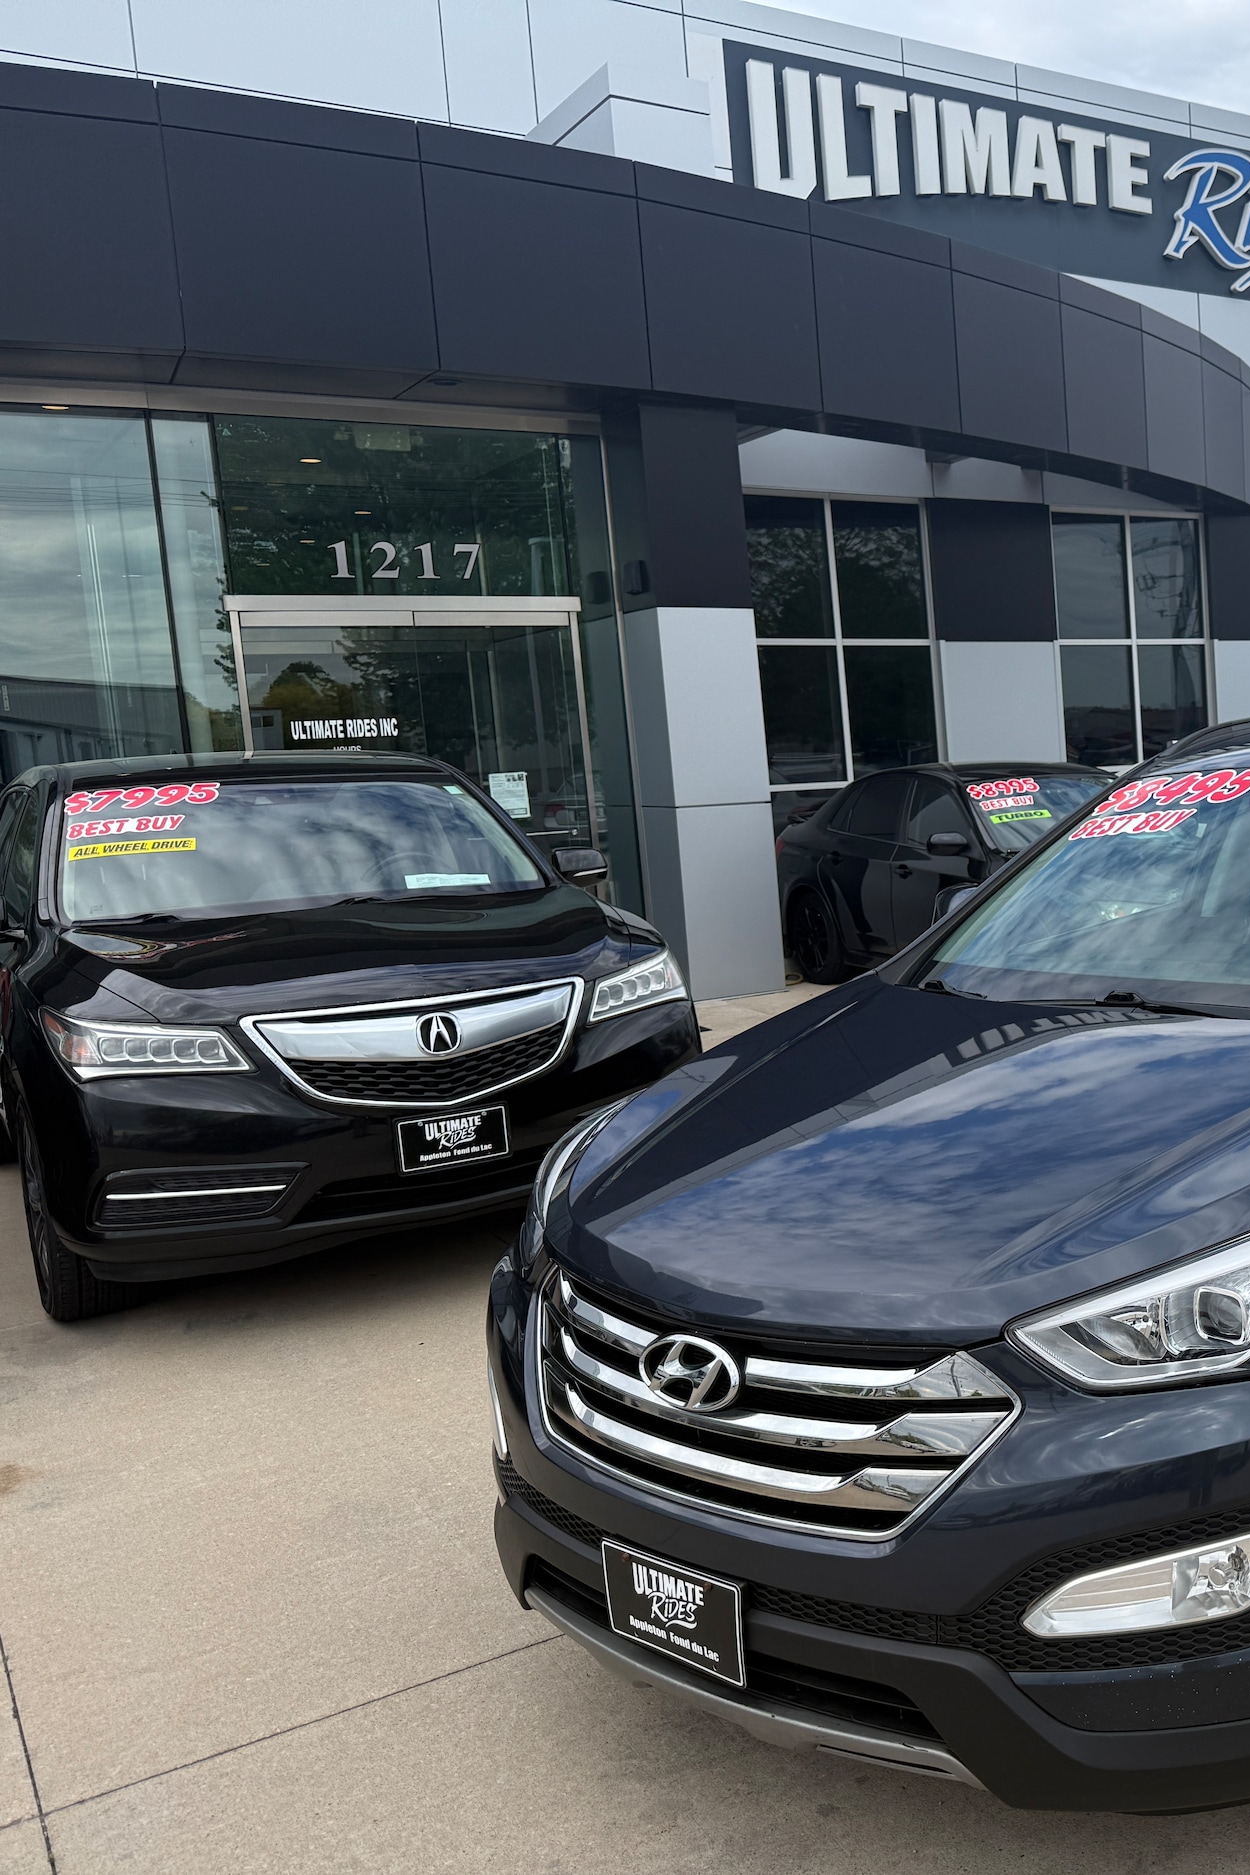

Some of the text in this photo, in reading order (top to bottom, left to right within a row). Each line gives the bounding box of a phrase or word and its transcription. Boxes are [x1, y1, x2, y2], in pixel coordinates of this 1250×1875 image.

[746, 59, 1152, 215] ULTIMATE
[326, 540, 481, 579] 1217
[290, 717, 398, 740] ULTIMATE RIDES INC
[64, 783, 220, 815] $7995
[966, 777, 1040, 799] $8995
[980, 795, 1034, 811] BEST BUY
[995, 811, 1043, 821] TURBO
[67, 815, 185, 839] BEST BUY
[1069, 809, 1197, 840] BEST BUY
[73, 839, 192, 858] ALL WHEEL DRIVE
[424, 1114, 481, 1141] ULTIMATE
[632, 1562, 705, 1606] ULTIMATE
[629, 1614, 720, 1662] Appleton Fond du Lac
